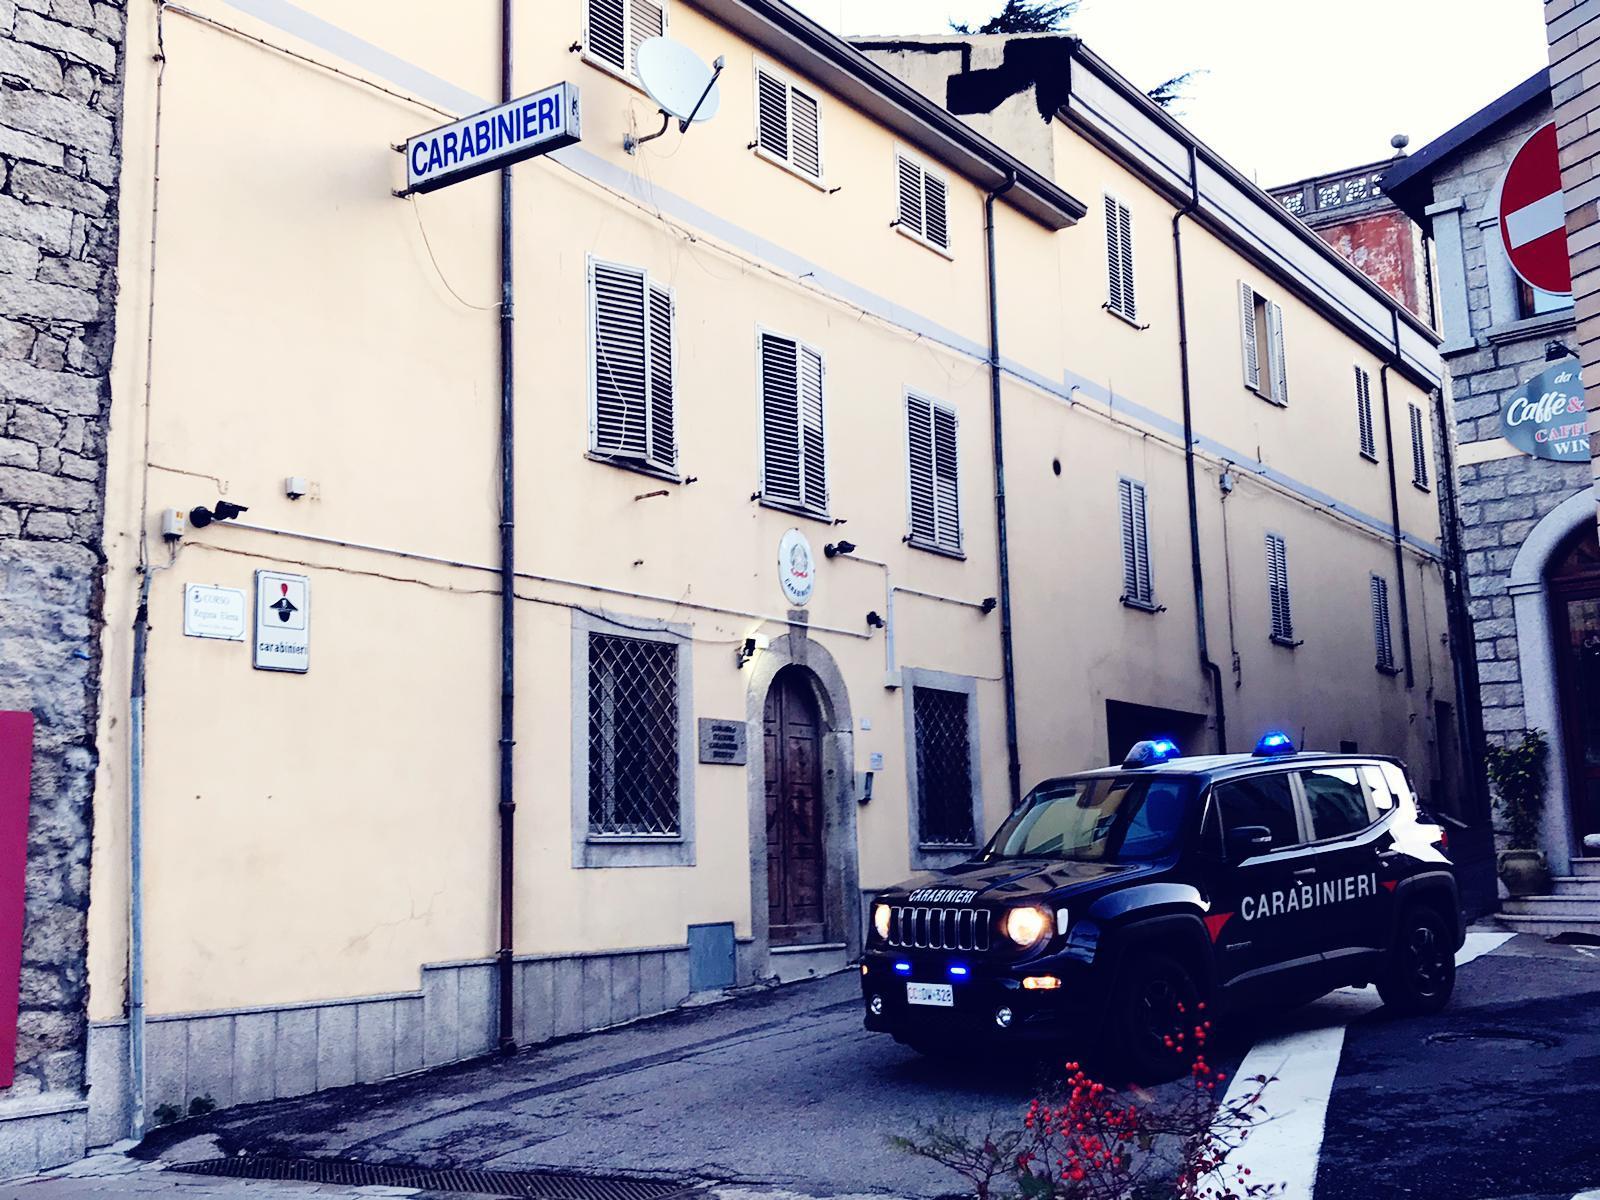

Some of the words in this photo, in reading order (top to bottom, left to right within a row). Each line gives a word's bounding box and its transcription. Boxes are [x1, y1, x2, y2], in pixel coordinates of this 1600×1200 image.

[412, 94, 560, 176] CARABINIERI
[1554, 371, 1572, 384] da
[1506, 391, 1567, 427] Caffè
[259, 642, 308, 655] carabinieri
[908, 888, 978, 904] CARABINIERI
[1241, 872, 1377, 921] CARABINIERI
